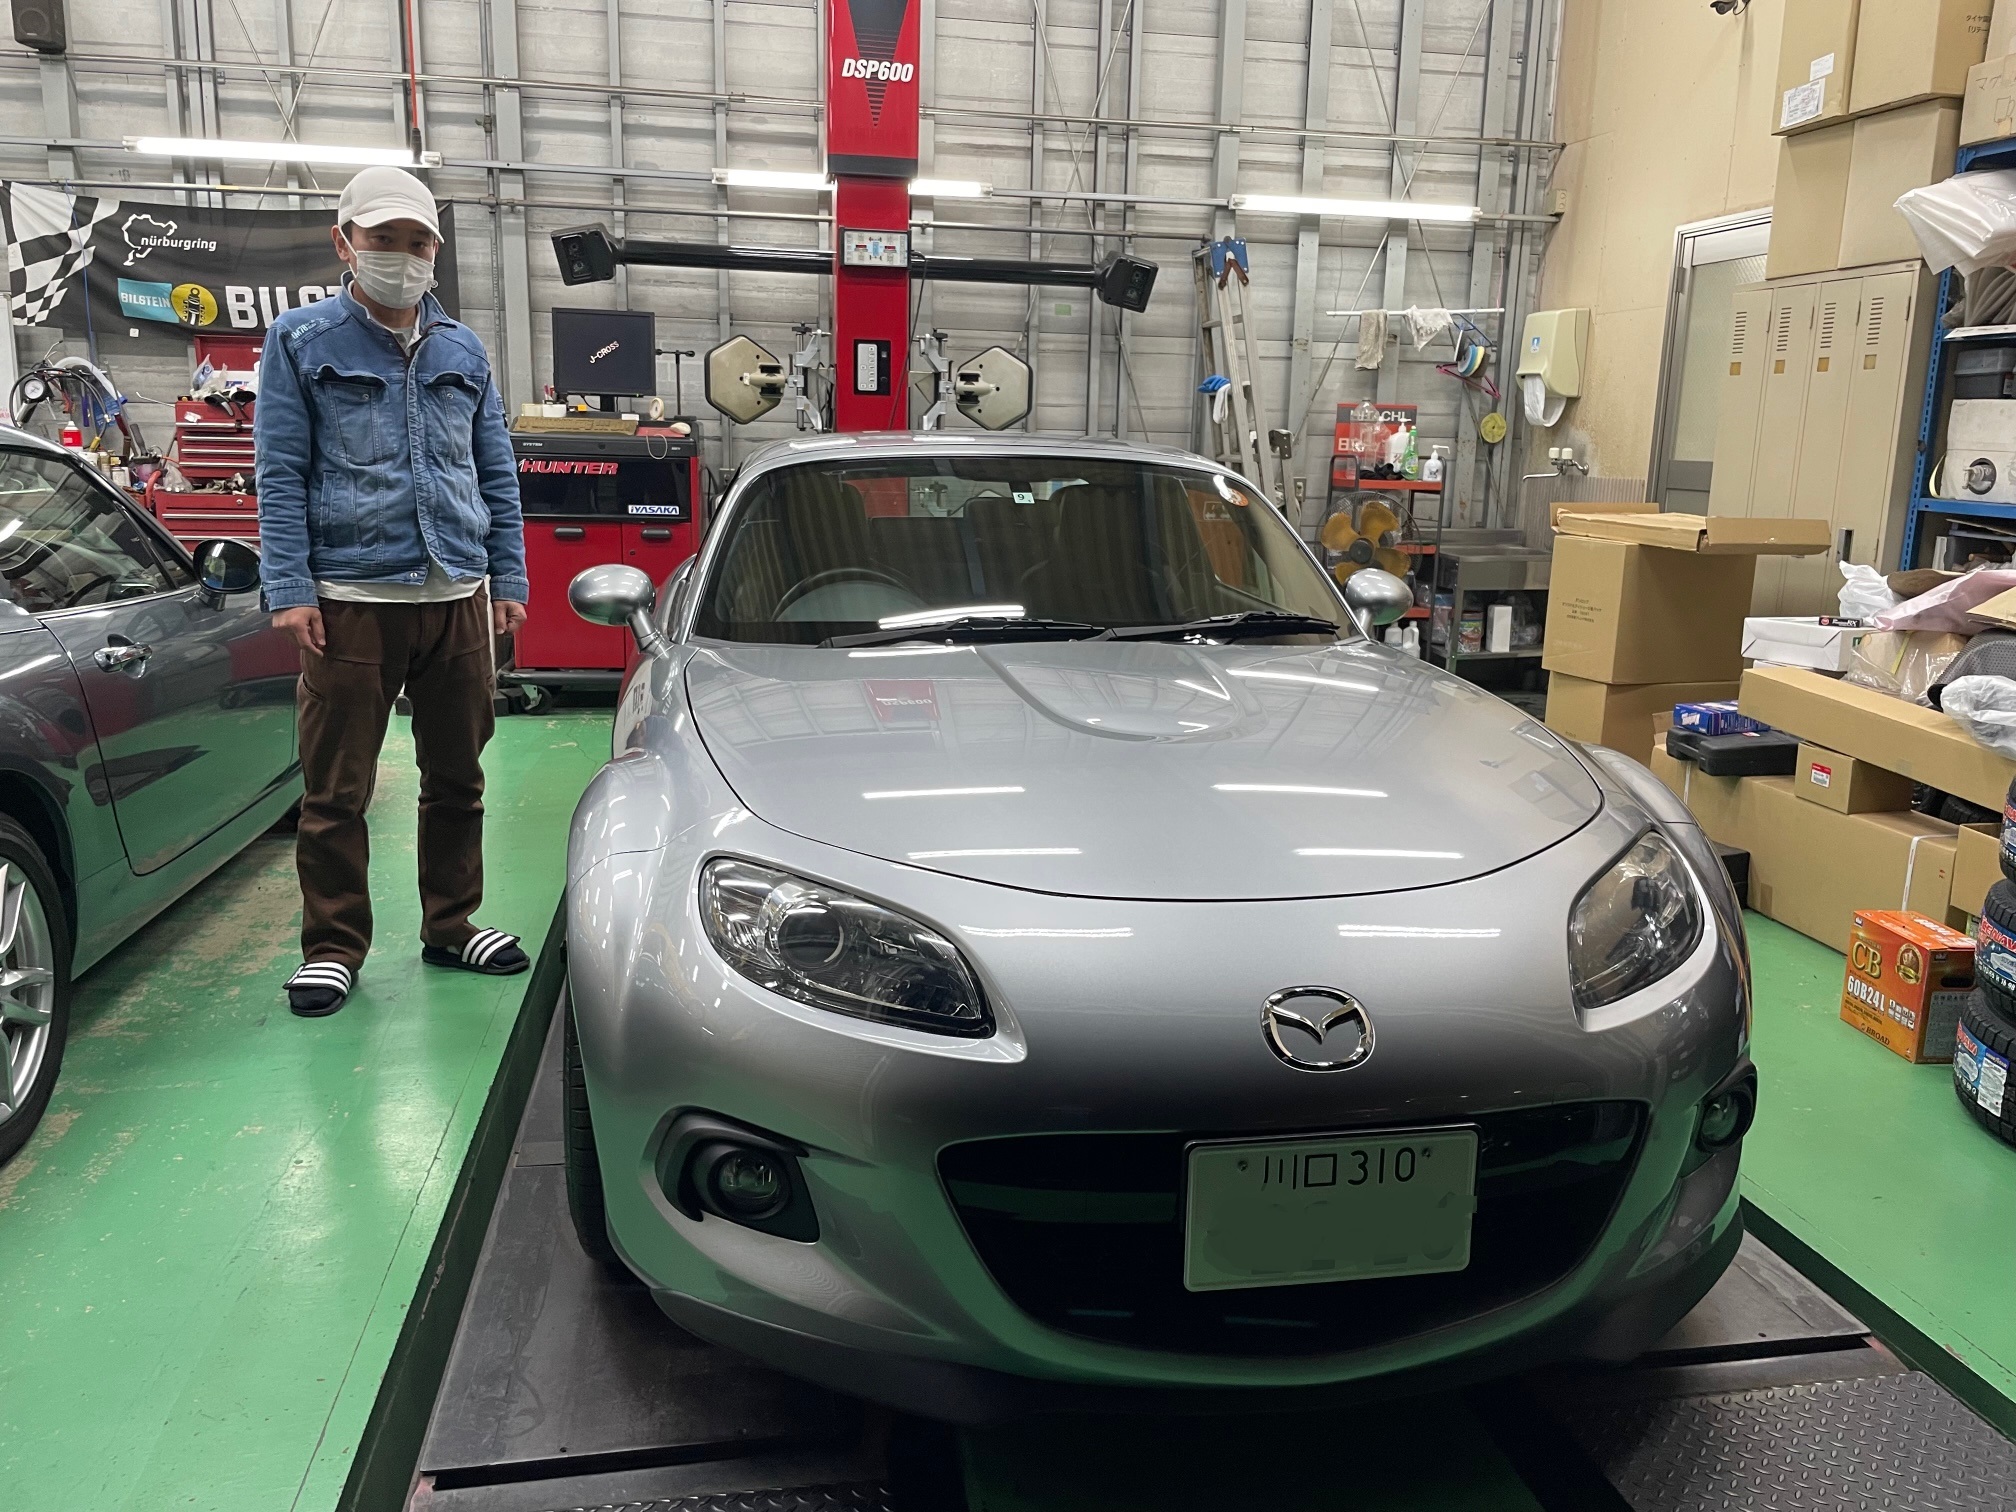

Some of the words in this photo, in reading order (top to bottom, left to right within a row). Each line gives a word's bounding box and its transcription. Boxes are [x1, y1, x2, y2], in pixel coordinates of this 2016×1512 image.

[841, 58, 914, 83] DSP600
[141, 236, 217, 252] nürburgring
[120, 291, 172, 309] BILSTEIN
[590, 340, 620, 364] J-CROSS
[520, 460, 619, 475] HUNTER
[1852, 941, 1882, 978] CB
[1866, 1026, 1891, 1047] BROAD
[1347, 1147, 1416, 1186] 310
